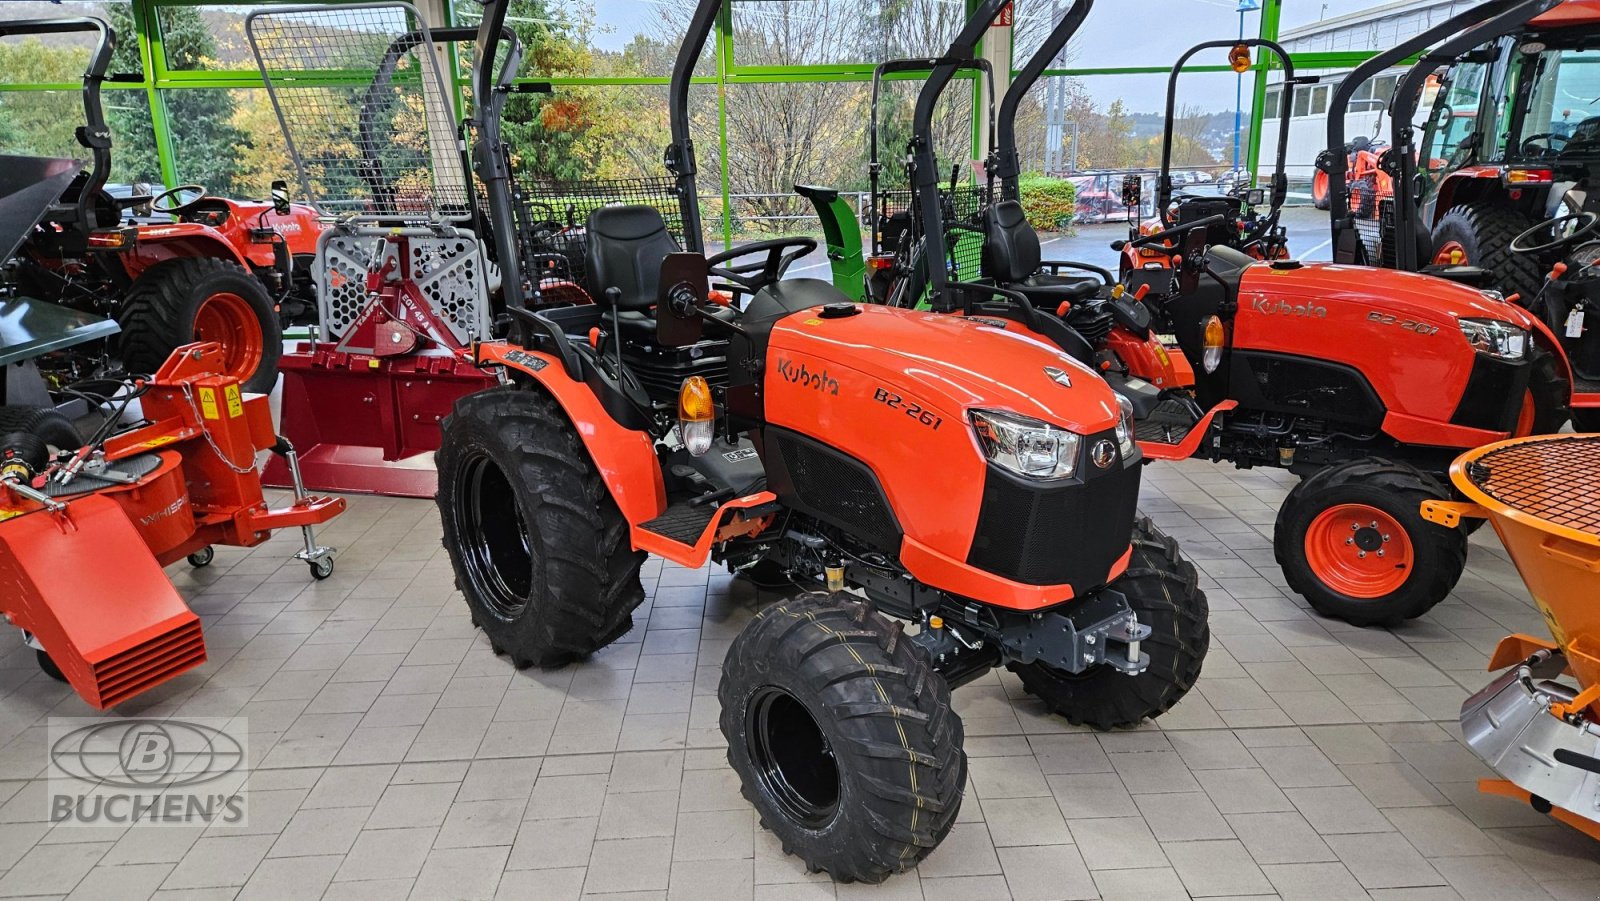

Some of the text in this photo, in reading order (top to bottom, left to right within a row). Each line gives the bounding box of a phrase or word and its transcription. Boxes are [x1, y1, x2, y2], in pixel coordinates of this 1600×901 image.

[402, 293, 417, 310] EGV
[414, 310, 425, 322] 45
[1252, 296, 1327, 319] Kubota
[1367, 310, 1439, 336] B2-201
[777, 357, 840, 396] Kubota
[873, 387, 943, 432] B2-261
[140, 496, 188, 526] WHISP
